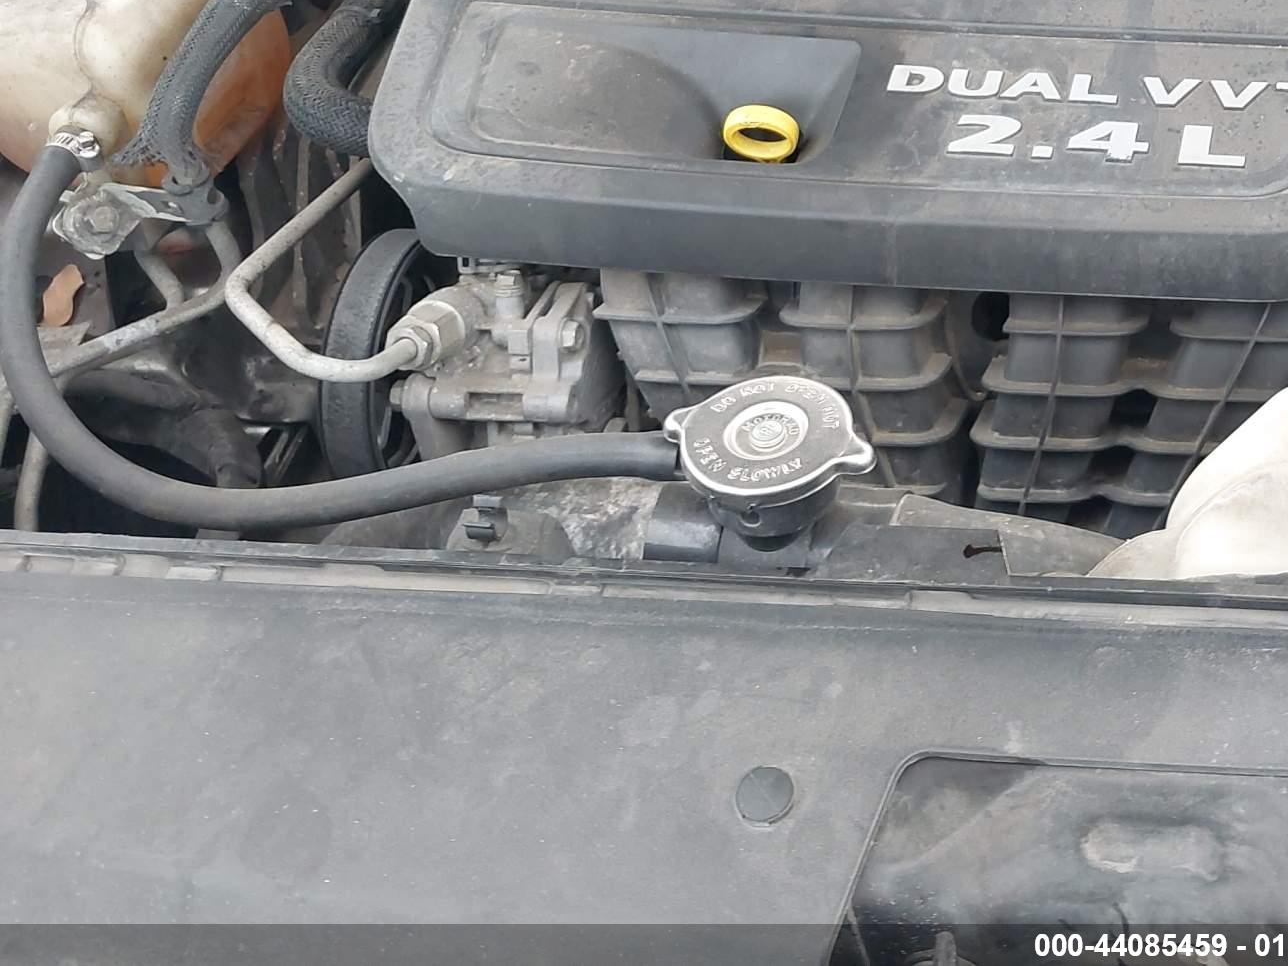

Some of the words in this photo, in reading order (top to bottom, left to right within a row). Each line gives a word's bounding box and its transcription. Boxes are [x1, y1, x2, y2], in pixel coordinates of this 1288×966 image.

[887, 64, 1119, 104] DUAL
[946, 114, 1150, 163] 2.4
[1177, 124, 1247, 168] L
[710, 395, 737, 413] DO
[739, 381, 776, 397] NOT
[784, 382, 829, 405] OPEN
